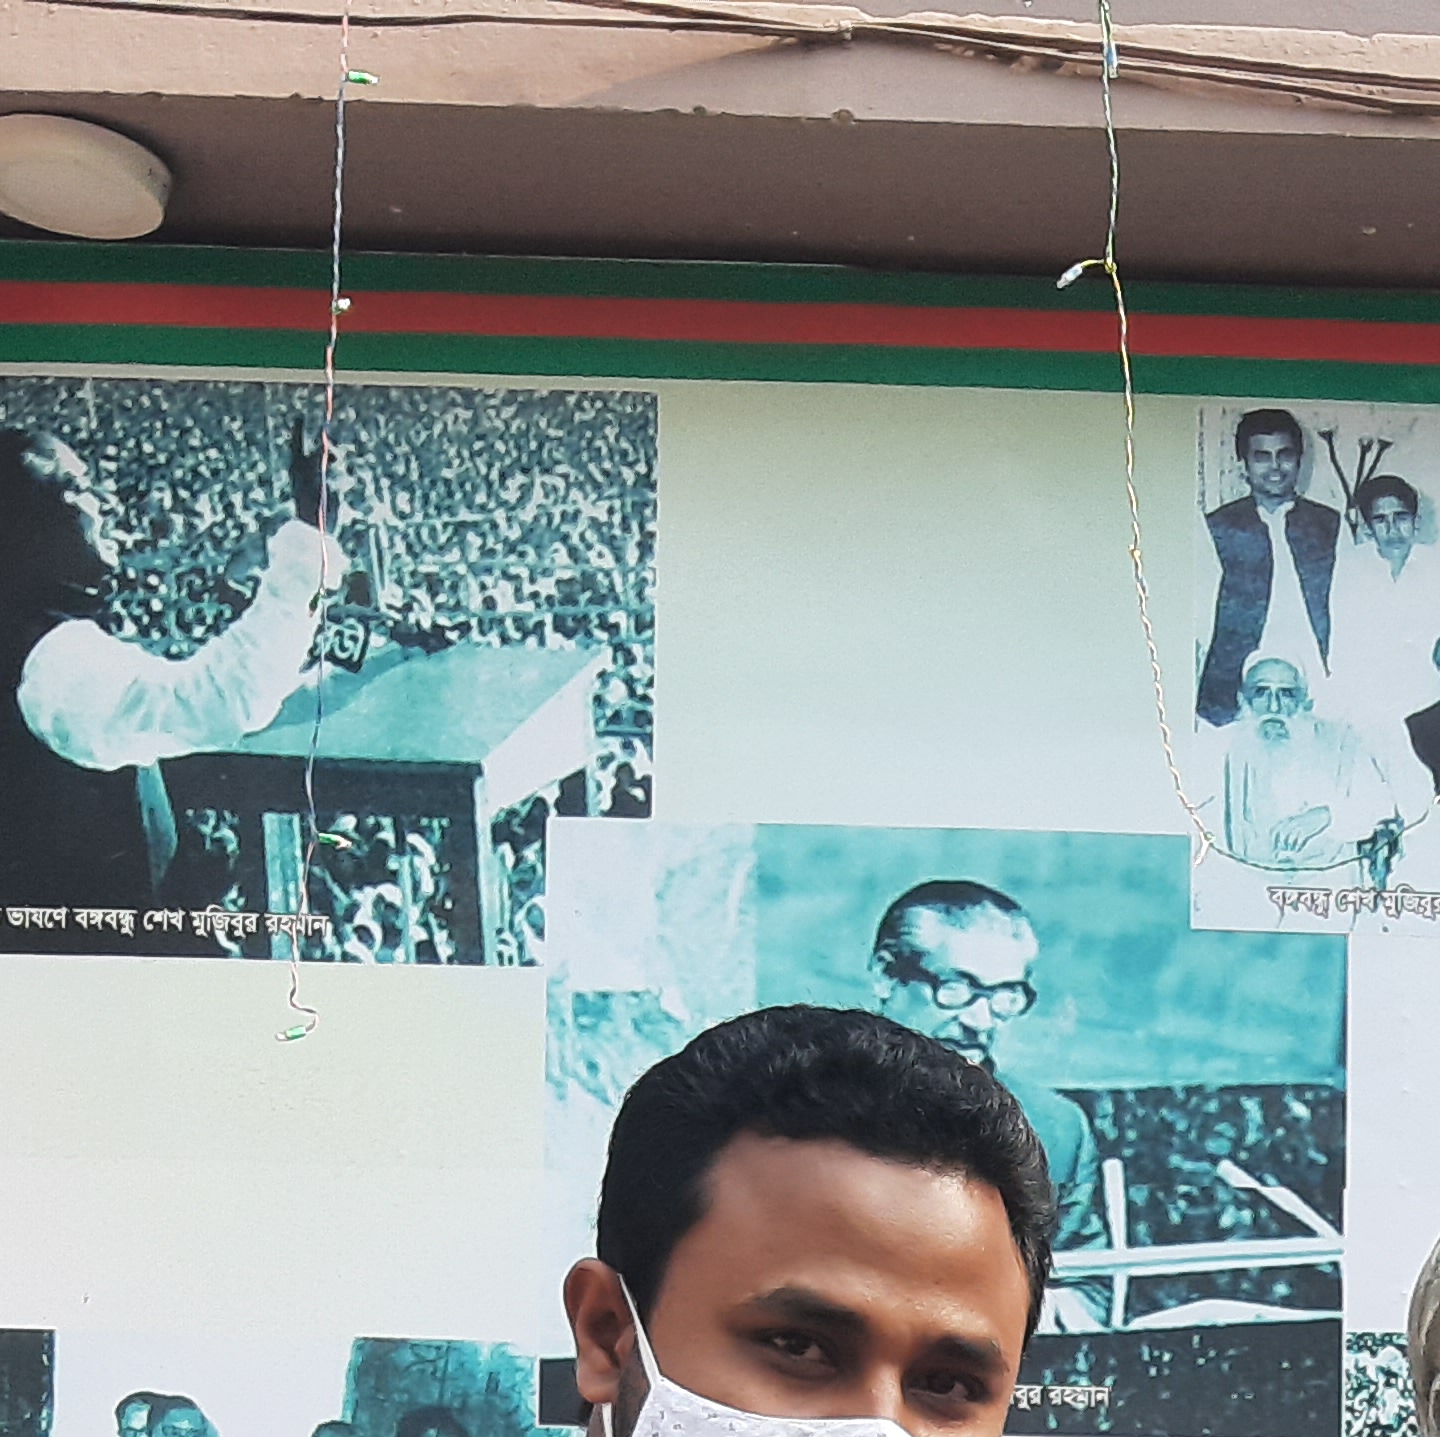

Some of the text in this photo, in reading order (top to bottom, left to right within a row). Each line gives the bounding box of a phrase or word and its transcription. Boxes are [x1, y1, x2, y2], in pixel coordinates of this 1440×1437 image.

[1335, 888, 1379, 915] শেখ
[72, 907, 138, 938] বঙ্গবন্ধু
[142, 909, 185, 933] শেখ
[190, 903, 259, 938] মুজিবুর
[264, 911, 330, 938] রহমান
